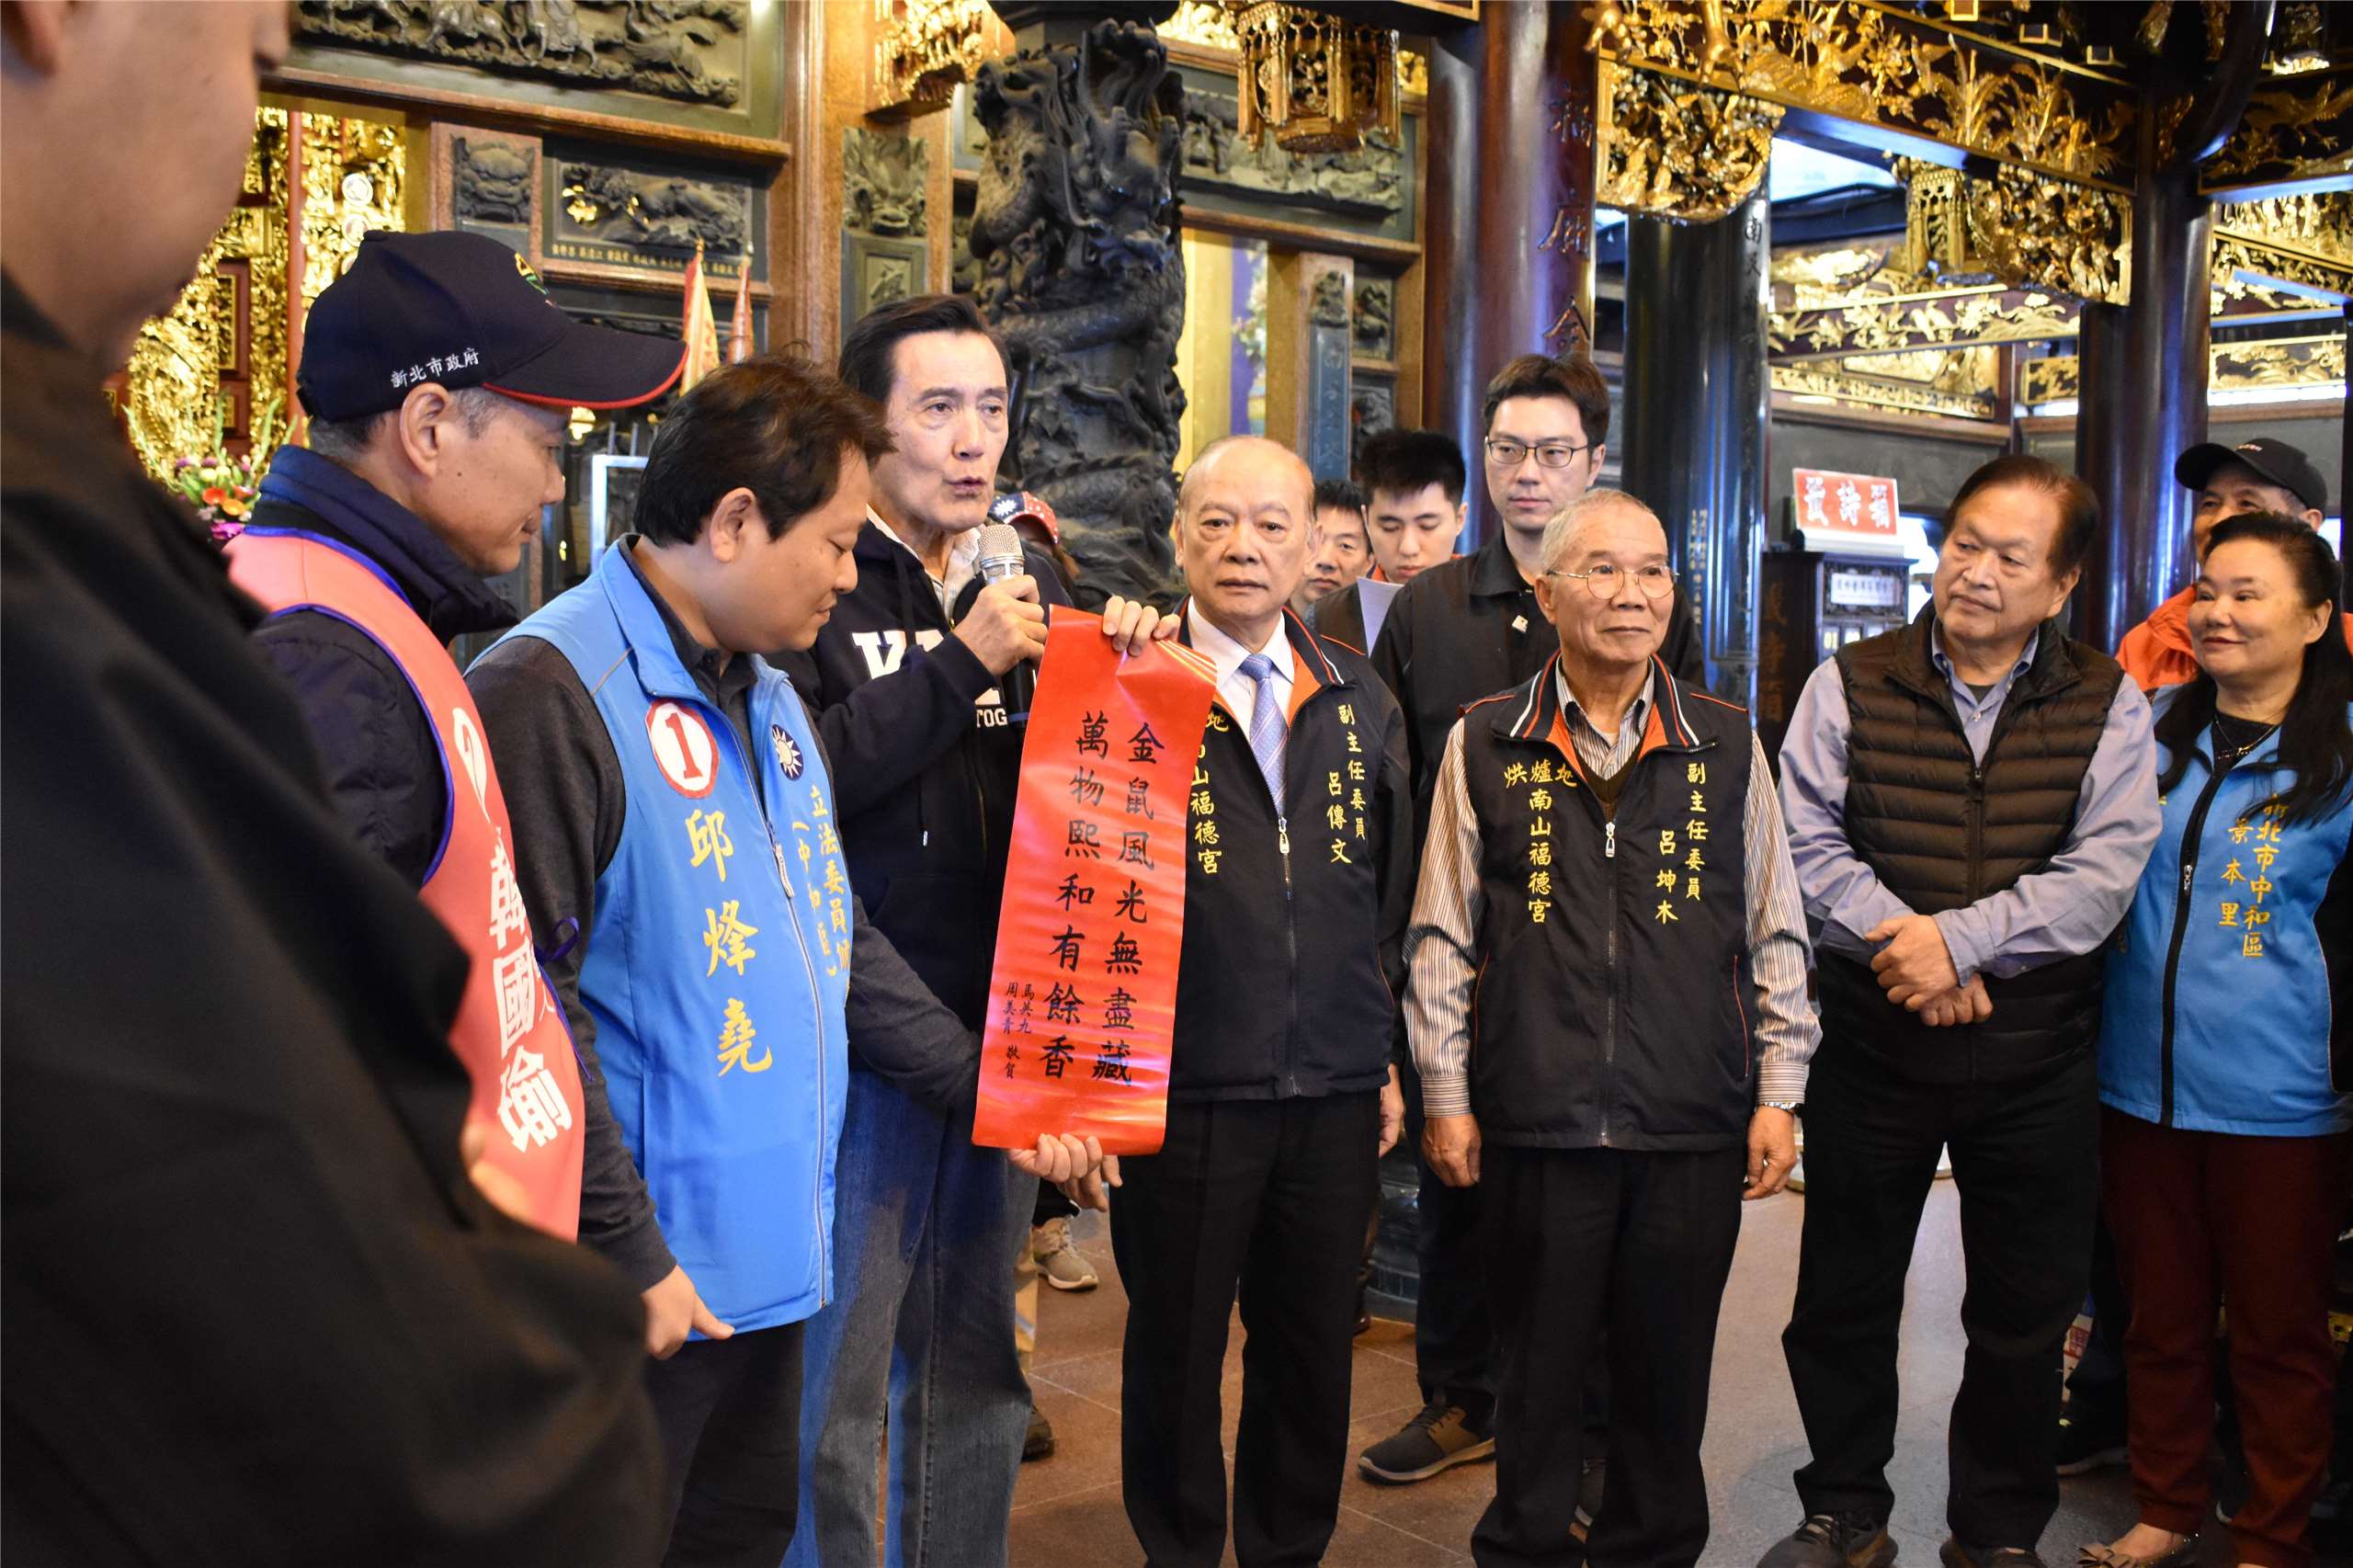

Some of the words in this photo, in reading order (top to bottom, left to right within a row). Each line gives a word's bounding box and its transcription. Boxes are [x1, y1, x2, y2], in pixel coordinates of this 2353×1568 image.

[391, 347, 479, 388] 新北市政府
[665, 711, 701, 780] 1
[1338, 703, 1366, 841] 副主任委員
[1504, 758, 1578, 789] 烘爐地
[1189, 744, 1222, 874] 山福德宮
[1326, 771, 1353, 864] 呂傳文
[1528, 789, 1553, 925] 南山福德宮
[1685, 762, 1710, 902] 副主任委員
[1038, 710, 1110, 1081] 萬物熙和有餘香
[1092, 721, 1165, 1086] 金鼠風光無盡藏
[1654, 830, 1679, 925] 呂坤木
[2218, 817, 2255, 927] 景本里
[489, 835, 572, 1153] 韓國瑜
[684, 808, 773, 1077] 邱烽堯
[1002, 981, 1018, 1035] 周美青
[1005, 1043, 1020, 1080] 敬賀
[1017, 983, 1035, 1034] 馬英九
